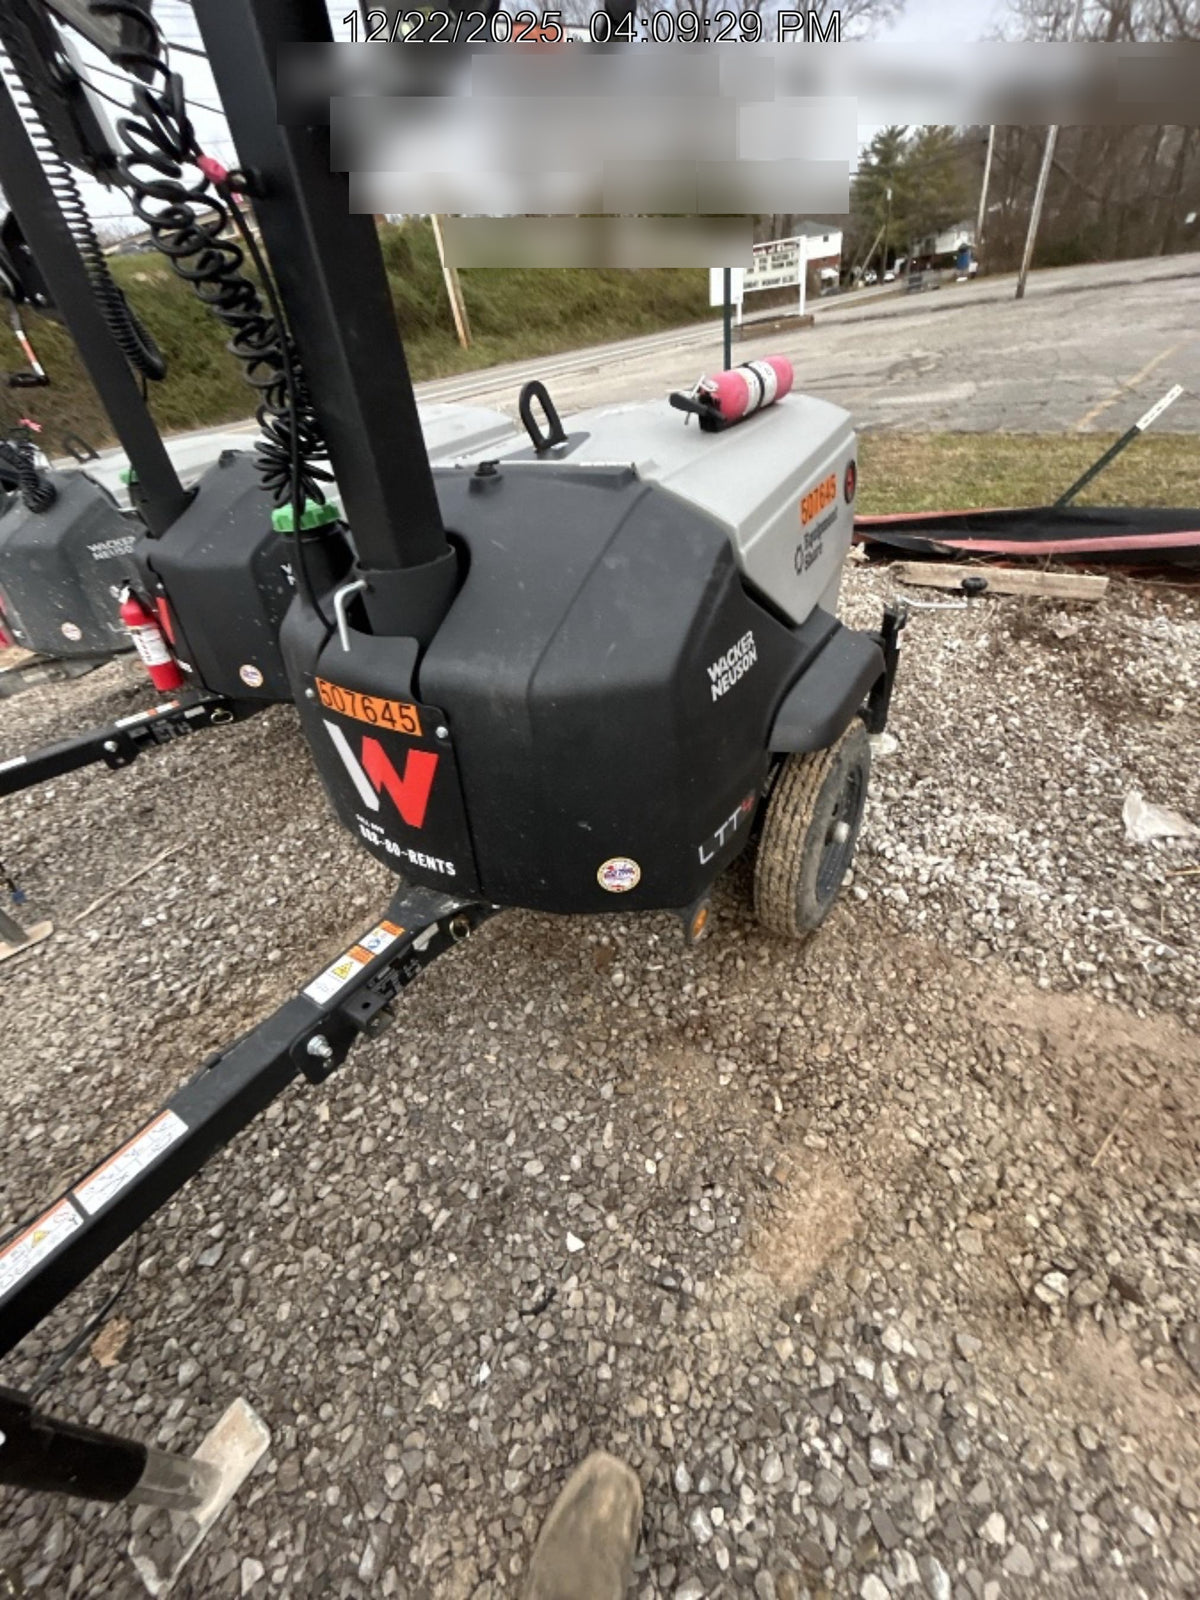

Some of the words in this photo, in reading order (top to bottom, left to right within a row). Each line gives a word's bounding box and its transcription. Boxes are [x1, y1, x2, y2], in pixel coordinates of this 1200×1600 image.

[92, 545, 134, 560] NEUSO
[707, 630, 754, 682] WACKER
[711, 645, 757, 702] NEUSON
[319, 680, 416, 733] 507645
